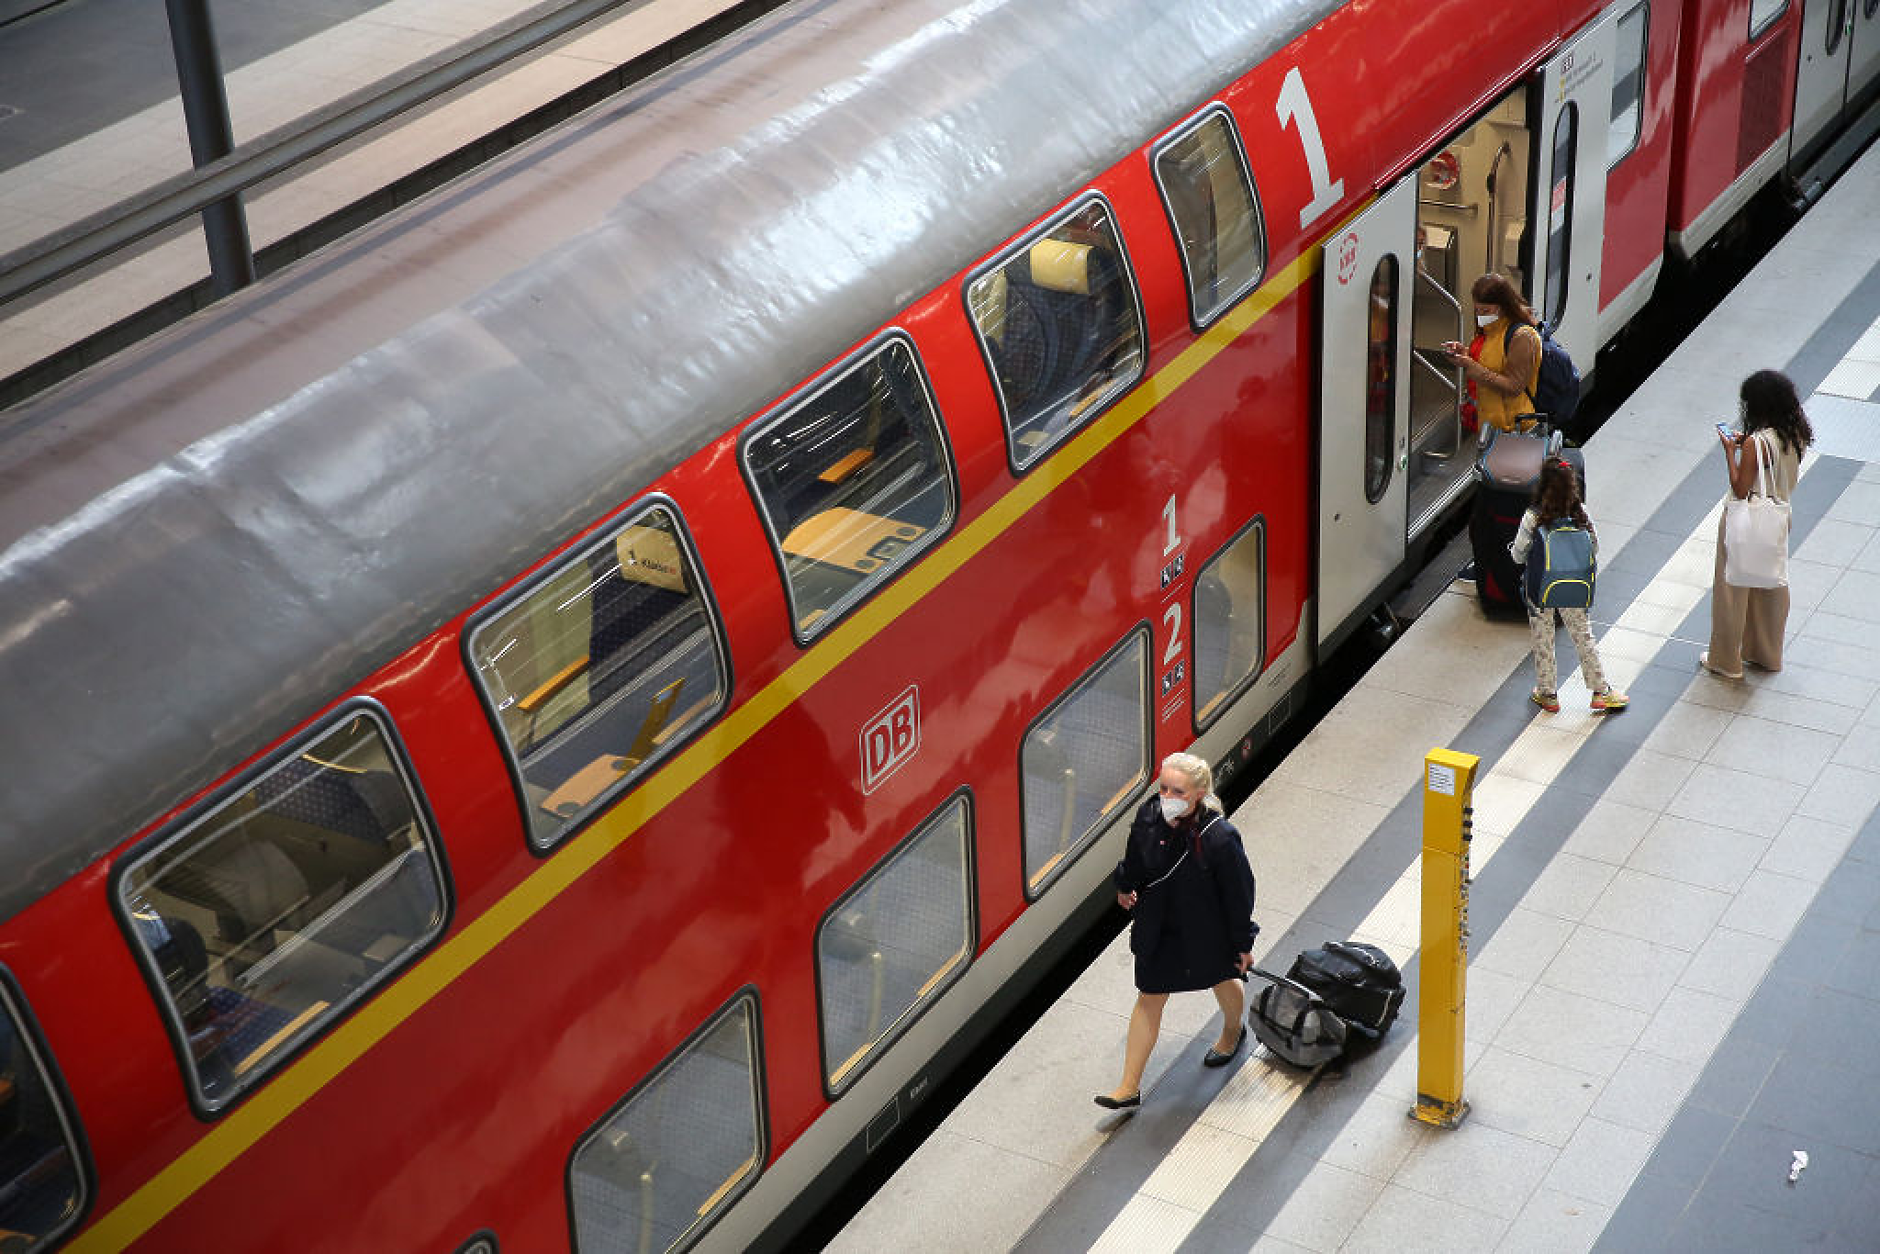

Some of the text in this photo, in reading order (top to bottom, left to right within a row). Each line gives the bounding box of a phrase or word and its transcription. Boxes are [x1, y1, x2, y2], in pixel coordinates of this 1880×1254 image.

[1276, 66, 1345, 231] 1
[1163, 494, 1181, 557] 1
[1163, 602, 1183, 666] 2
[866, 696, 915, 785] DB
